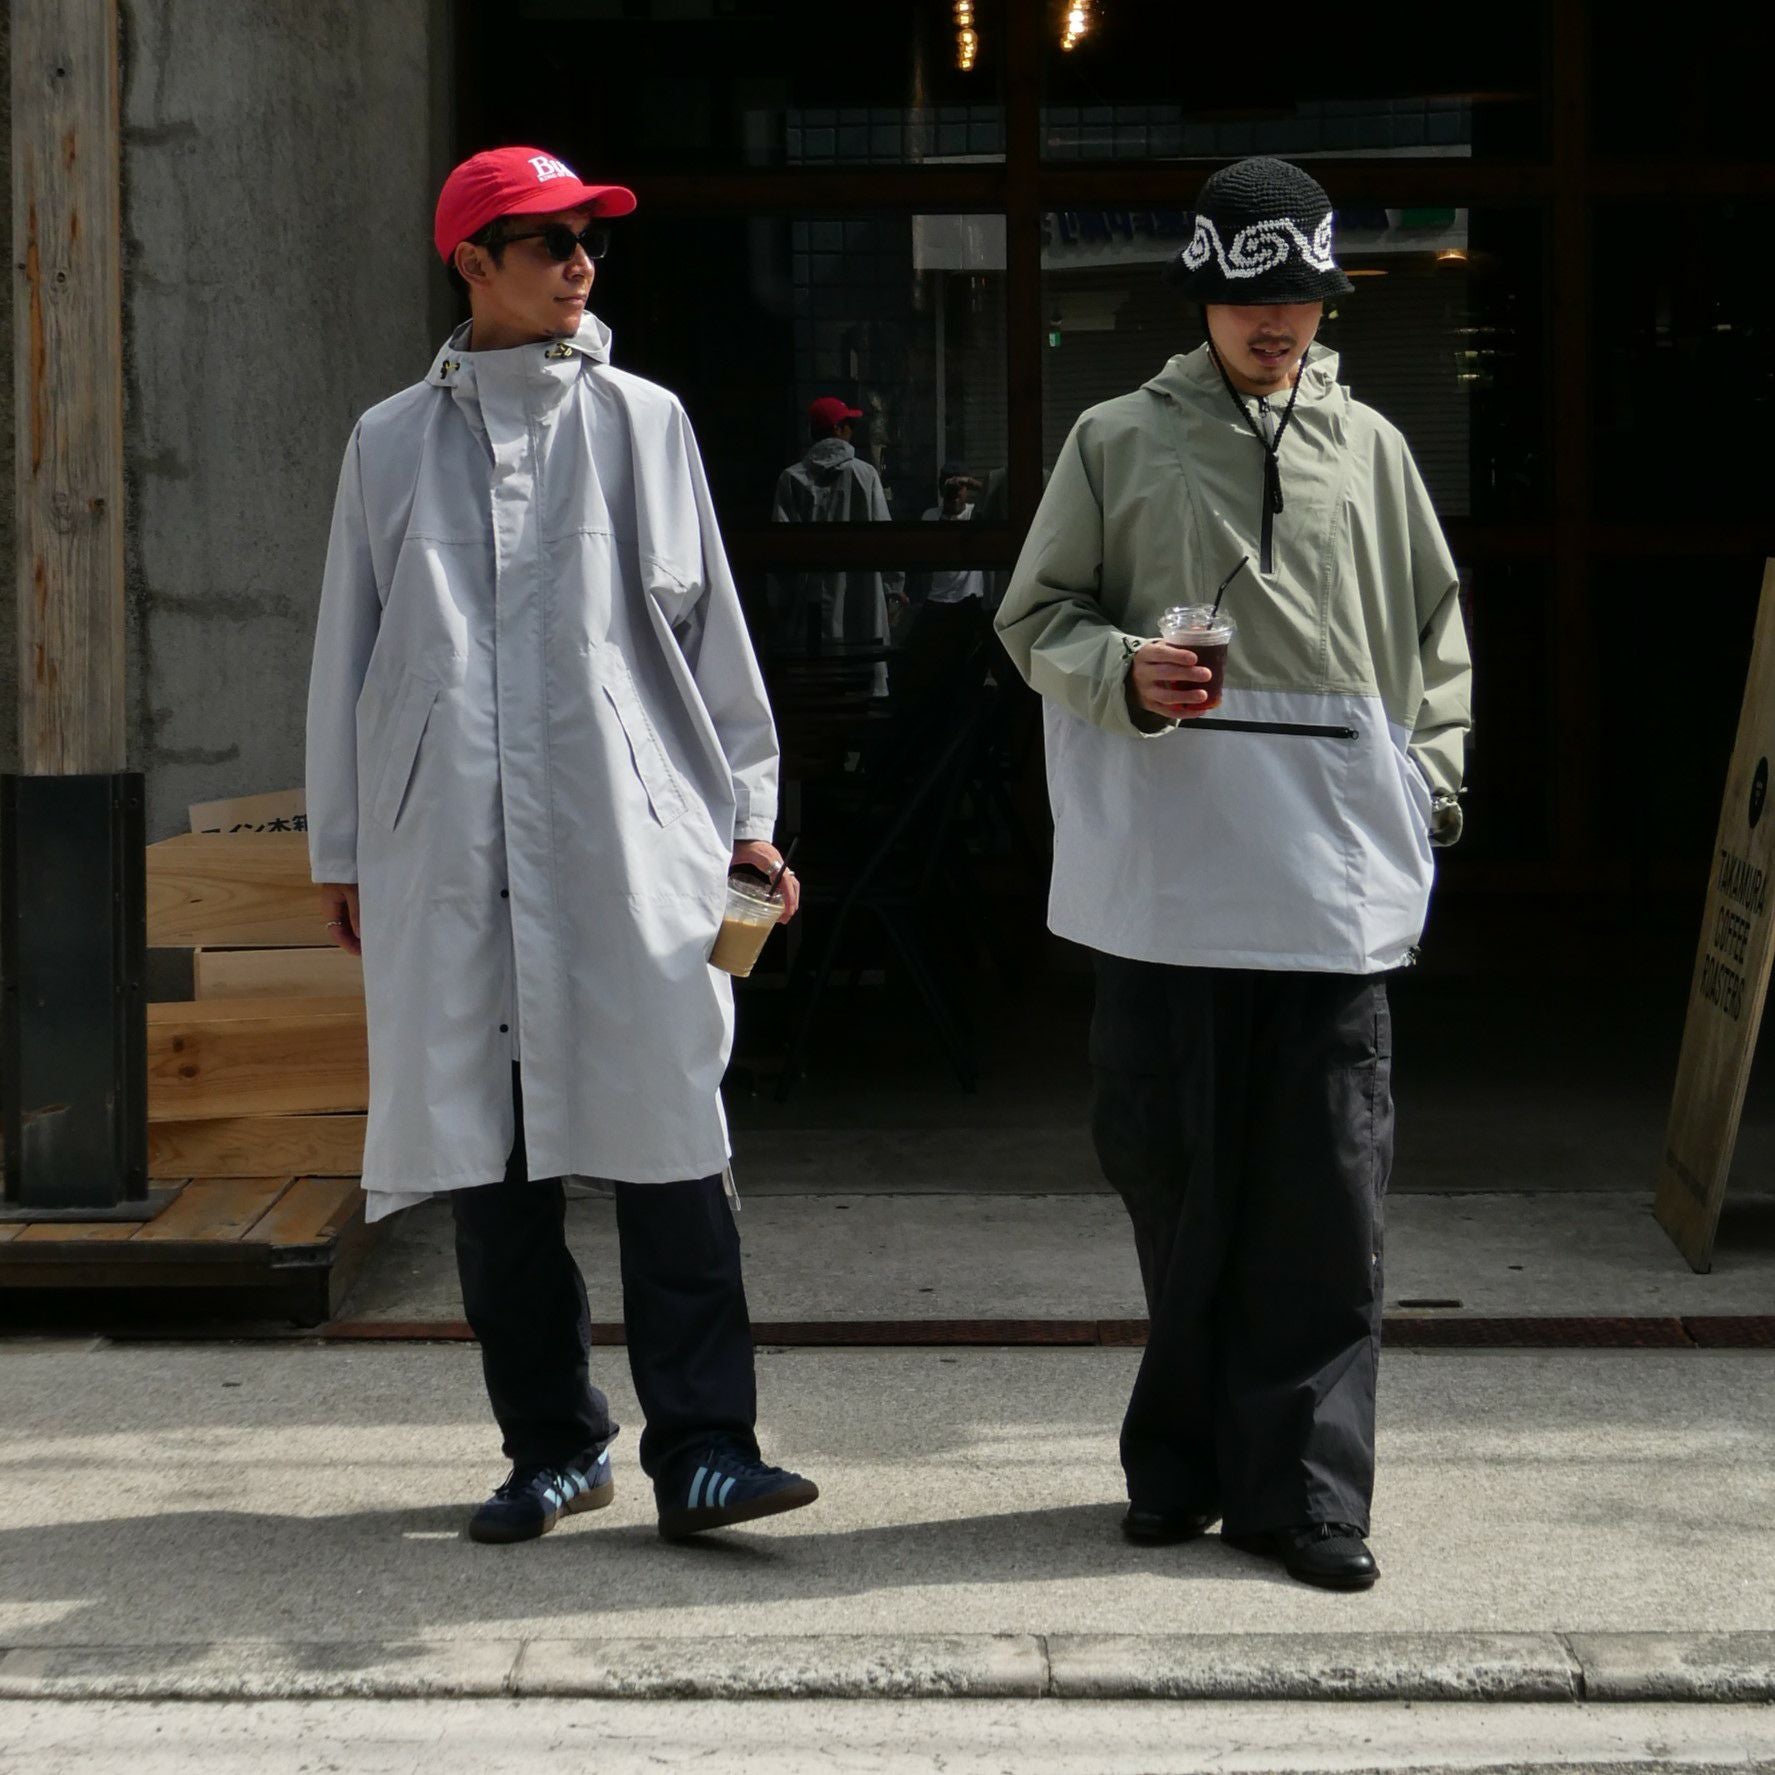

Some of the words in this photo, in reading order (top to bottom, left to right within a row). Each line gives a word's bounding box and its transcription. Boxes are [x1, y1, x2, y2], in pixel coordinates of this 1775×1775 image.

[1717, 849, 1767, 917] TAKAMURA
[1714, 906, 1750, 964] COFFEE
[1701, 954, 1745, 1021] ROASTERS
